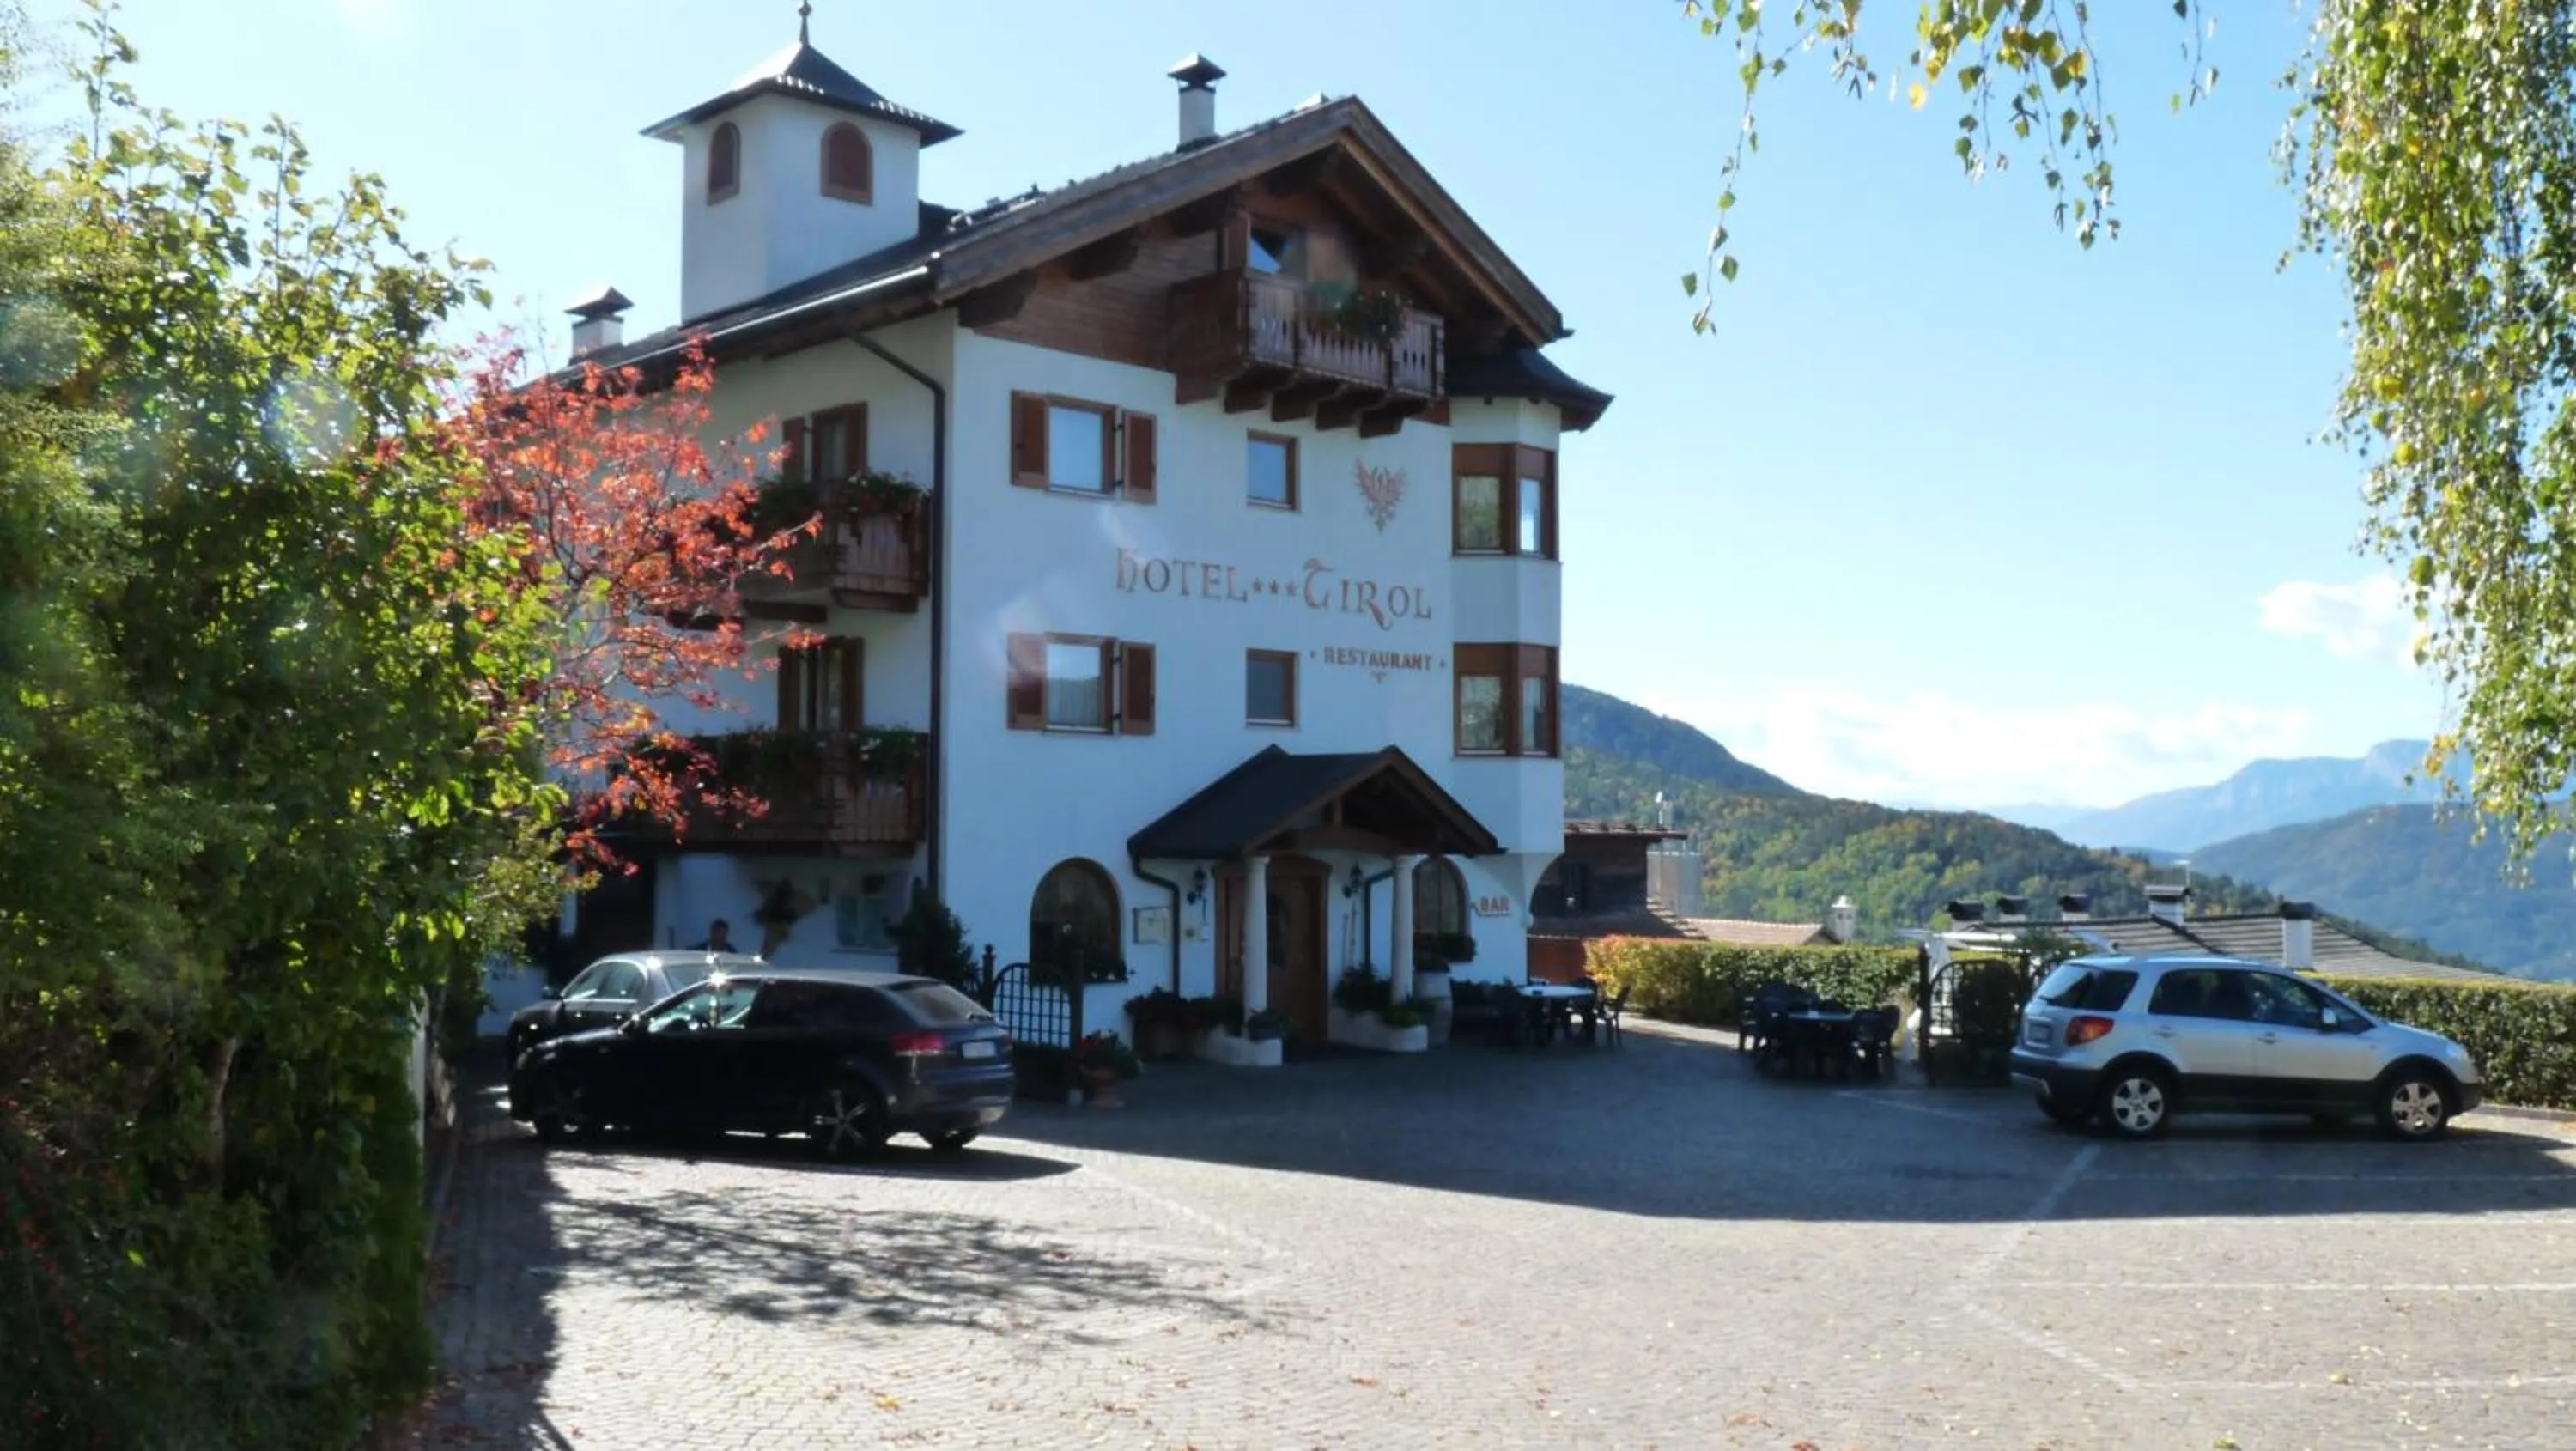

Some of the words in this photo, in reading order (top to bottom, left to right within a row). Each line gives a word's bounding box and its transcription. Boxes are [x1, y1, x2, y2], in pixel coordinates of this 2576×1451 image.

[1114, 547, 1248, 603] HOTEL
[1303, 558, 1432, 631] TIROL
[1324, 646, 1433, 671] RESTAURANT
[1479, 895, 1510, 912] BAR
